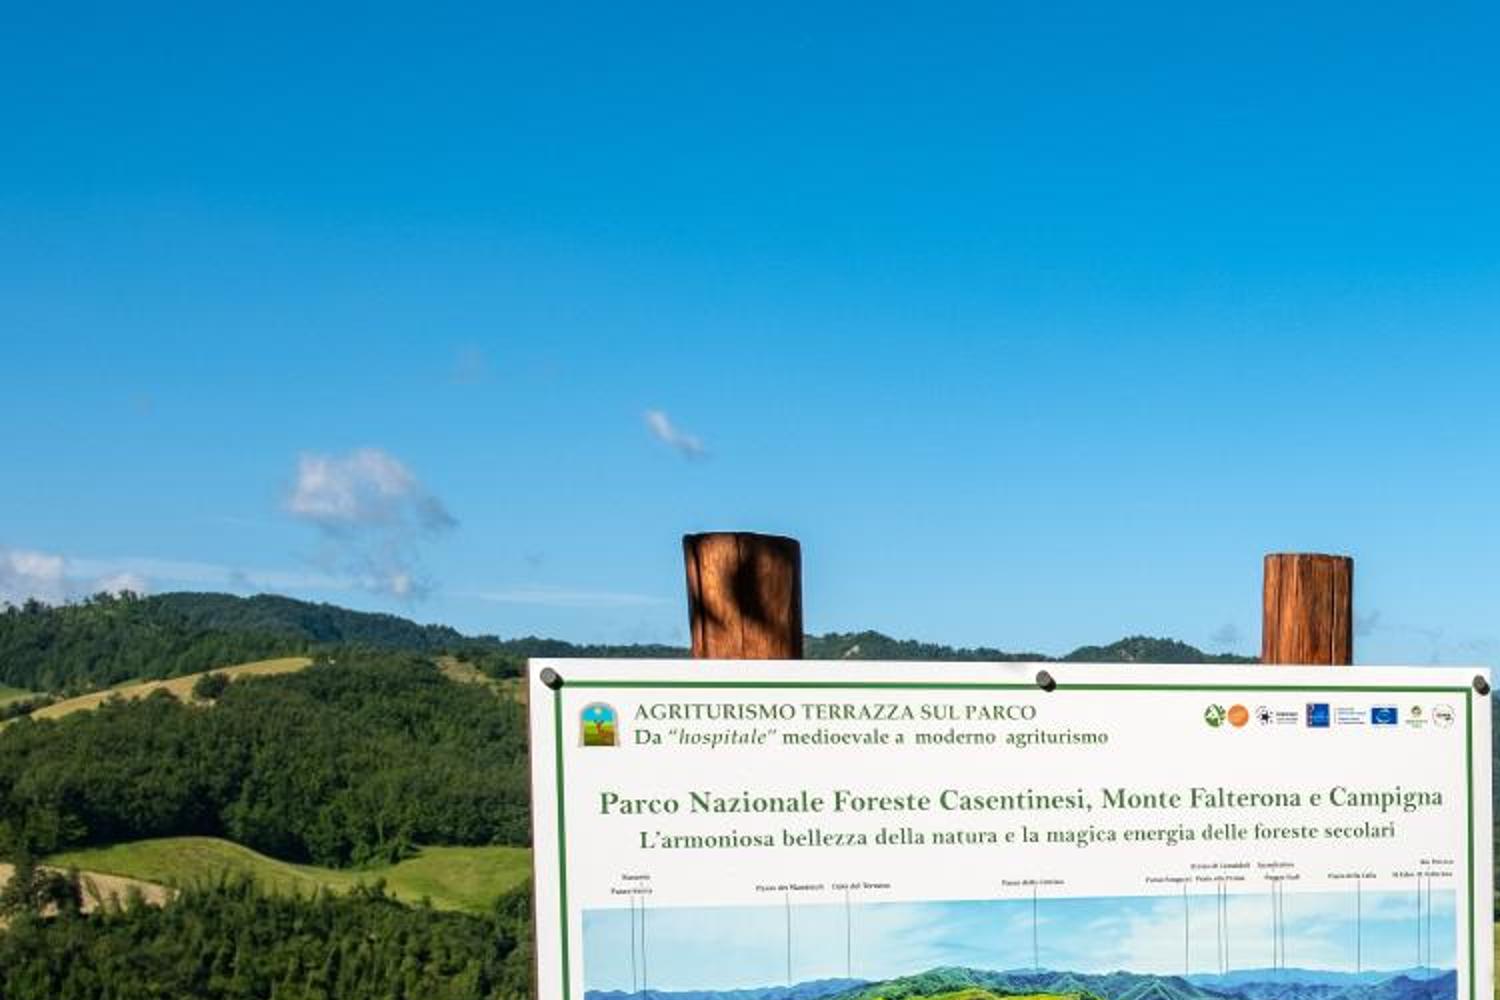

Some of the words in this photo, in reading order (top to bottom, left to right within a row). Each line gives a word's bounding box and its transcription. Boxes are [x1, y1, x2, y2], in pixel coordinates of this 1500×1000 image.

[635, 703, 795, 721] AGRITURISMO
[801, 703, 914, 721] TERRAZZA
[920, 703, 960, 720] SUL
[965, 703, 1037, 720] PARCO
[634, 728, 662, 745] Da
[782, 728, 889, 745] medioevale
[894, 733, 905, 745] a
[915, 728, 996, 745] moderno
[1005, 728, 1109, 749] agriturismo
[600, 791, 679, 815] Parco
[688, 789, 825, 813] Nazionale
[834, 790, 931, 813] Foreste
[939, 788, 1093, 813] Casentinesi,
[1102, 787, 1182, 809] Monte
[1190, 787, 1302, 809] Falterona
[1309, 793, 1322, 808] e
[1329, 785, 1443, 814] Campigna
[782, 828, 868, 847] bellezza
[874, 827, 925, 845] della
[932, 831, 998, 845] natura
[1004, 832, 1015, 843] e
[1022, 825, 1040, 843] la
[1046, 825, 1117, 849] magica
[1123, 823, 1195, 847] energia
[1201, 823, 1248, 841] delle
[1254, 823, 1319, 840] foreste
[1324, 821, 1395, 839] secolari
